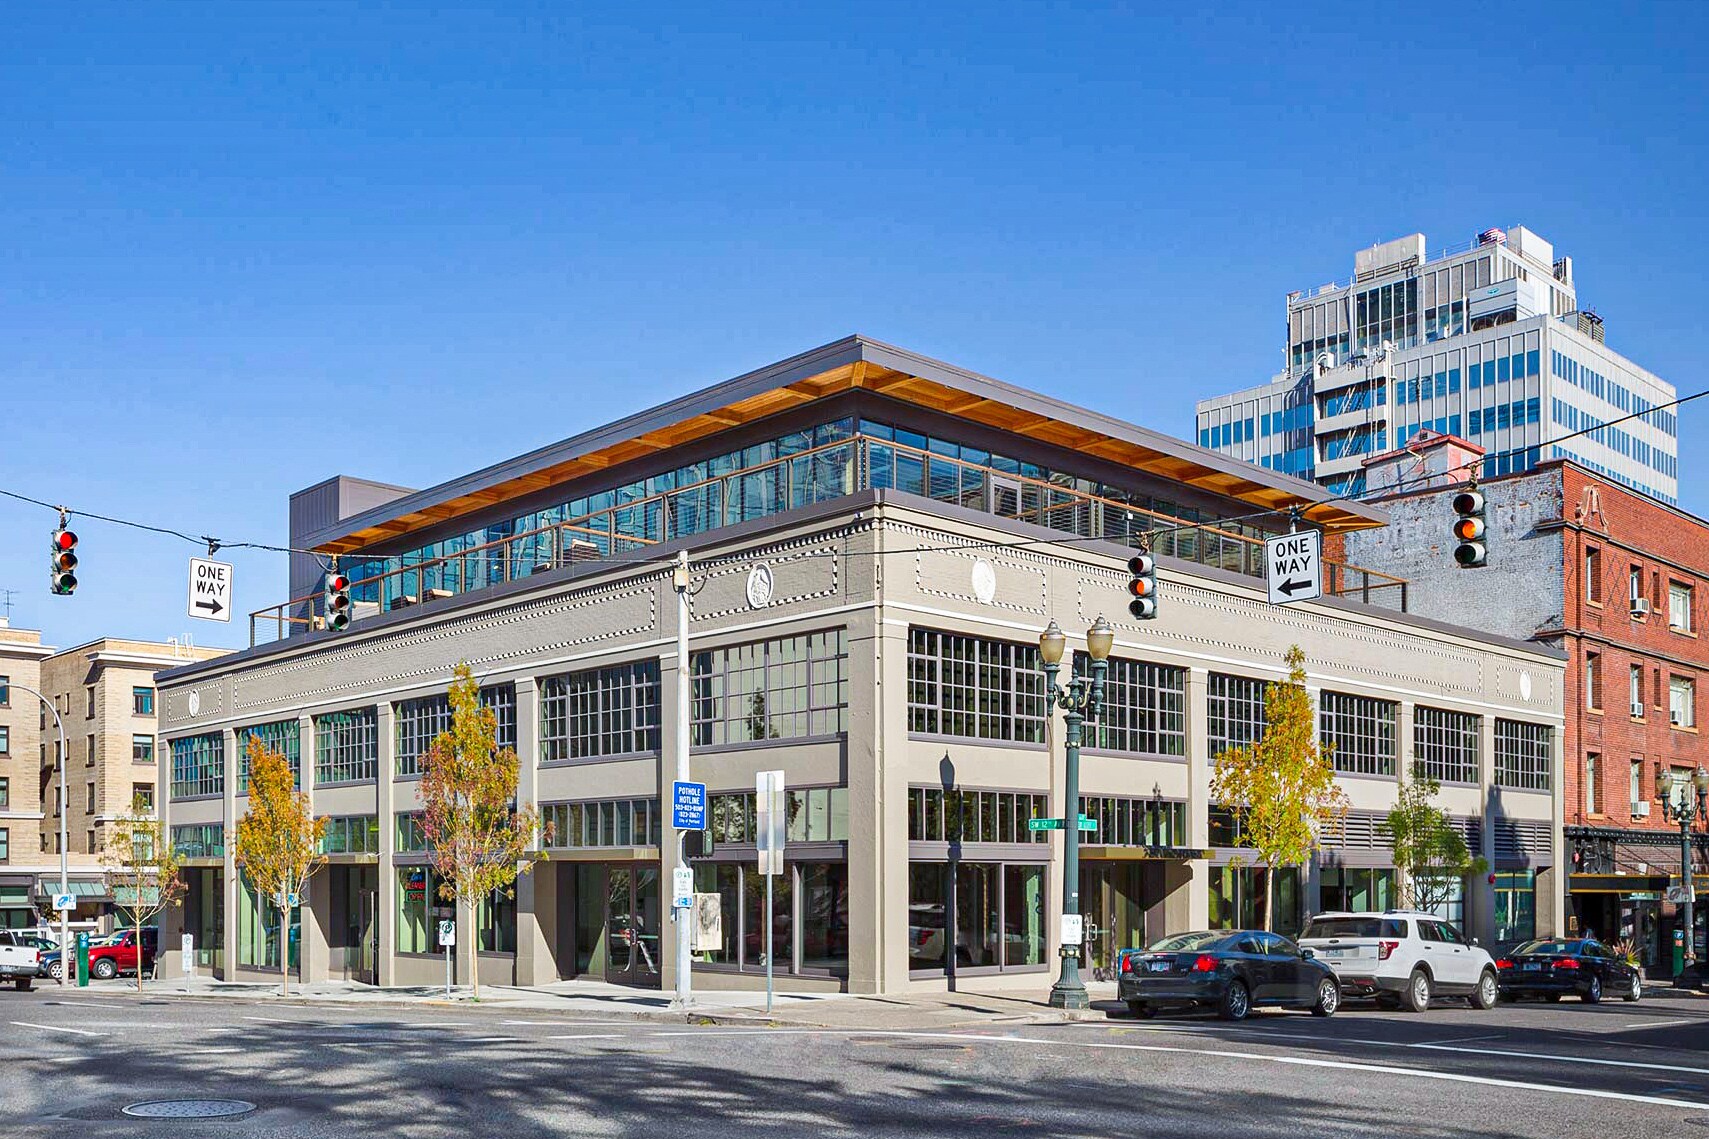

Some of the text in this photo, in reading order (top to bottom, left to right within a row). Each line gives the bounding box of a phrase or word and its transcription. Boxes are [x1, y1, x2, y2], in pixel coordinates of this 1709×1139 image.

[1275, 538, 1310, 558] ONE
[198, 565, 225, 581] ONE
[1275, 555, 1311, 576] WAY
[197, 580, 226, 596] WAY
[678, 786, 701, 797] POTHOLE
[679, 795, 700, 805] HOTLINE
[1030, 820, 1039, 829] SW
